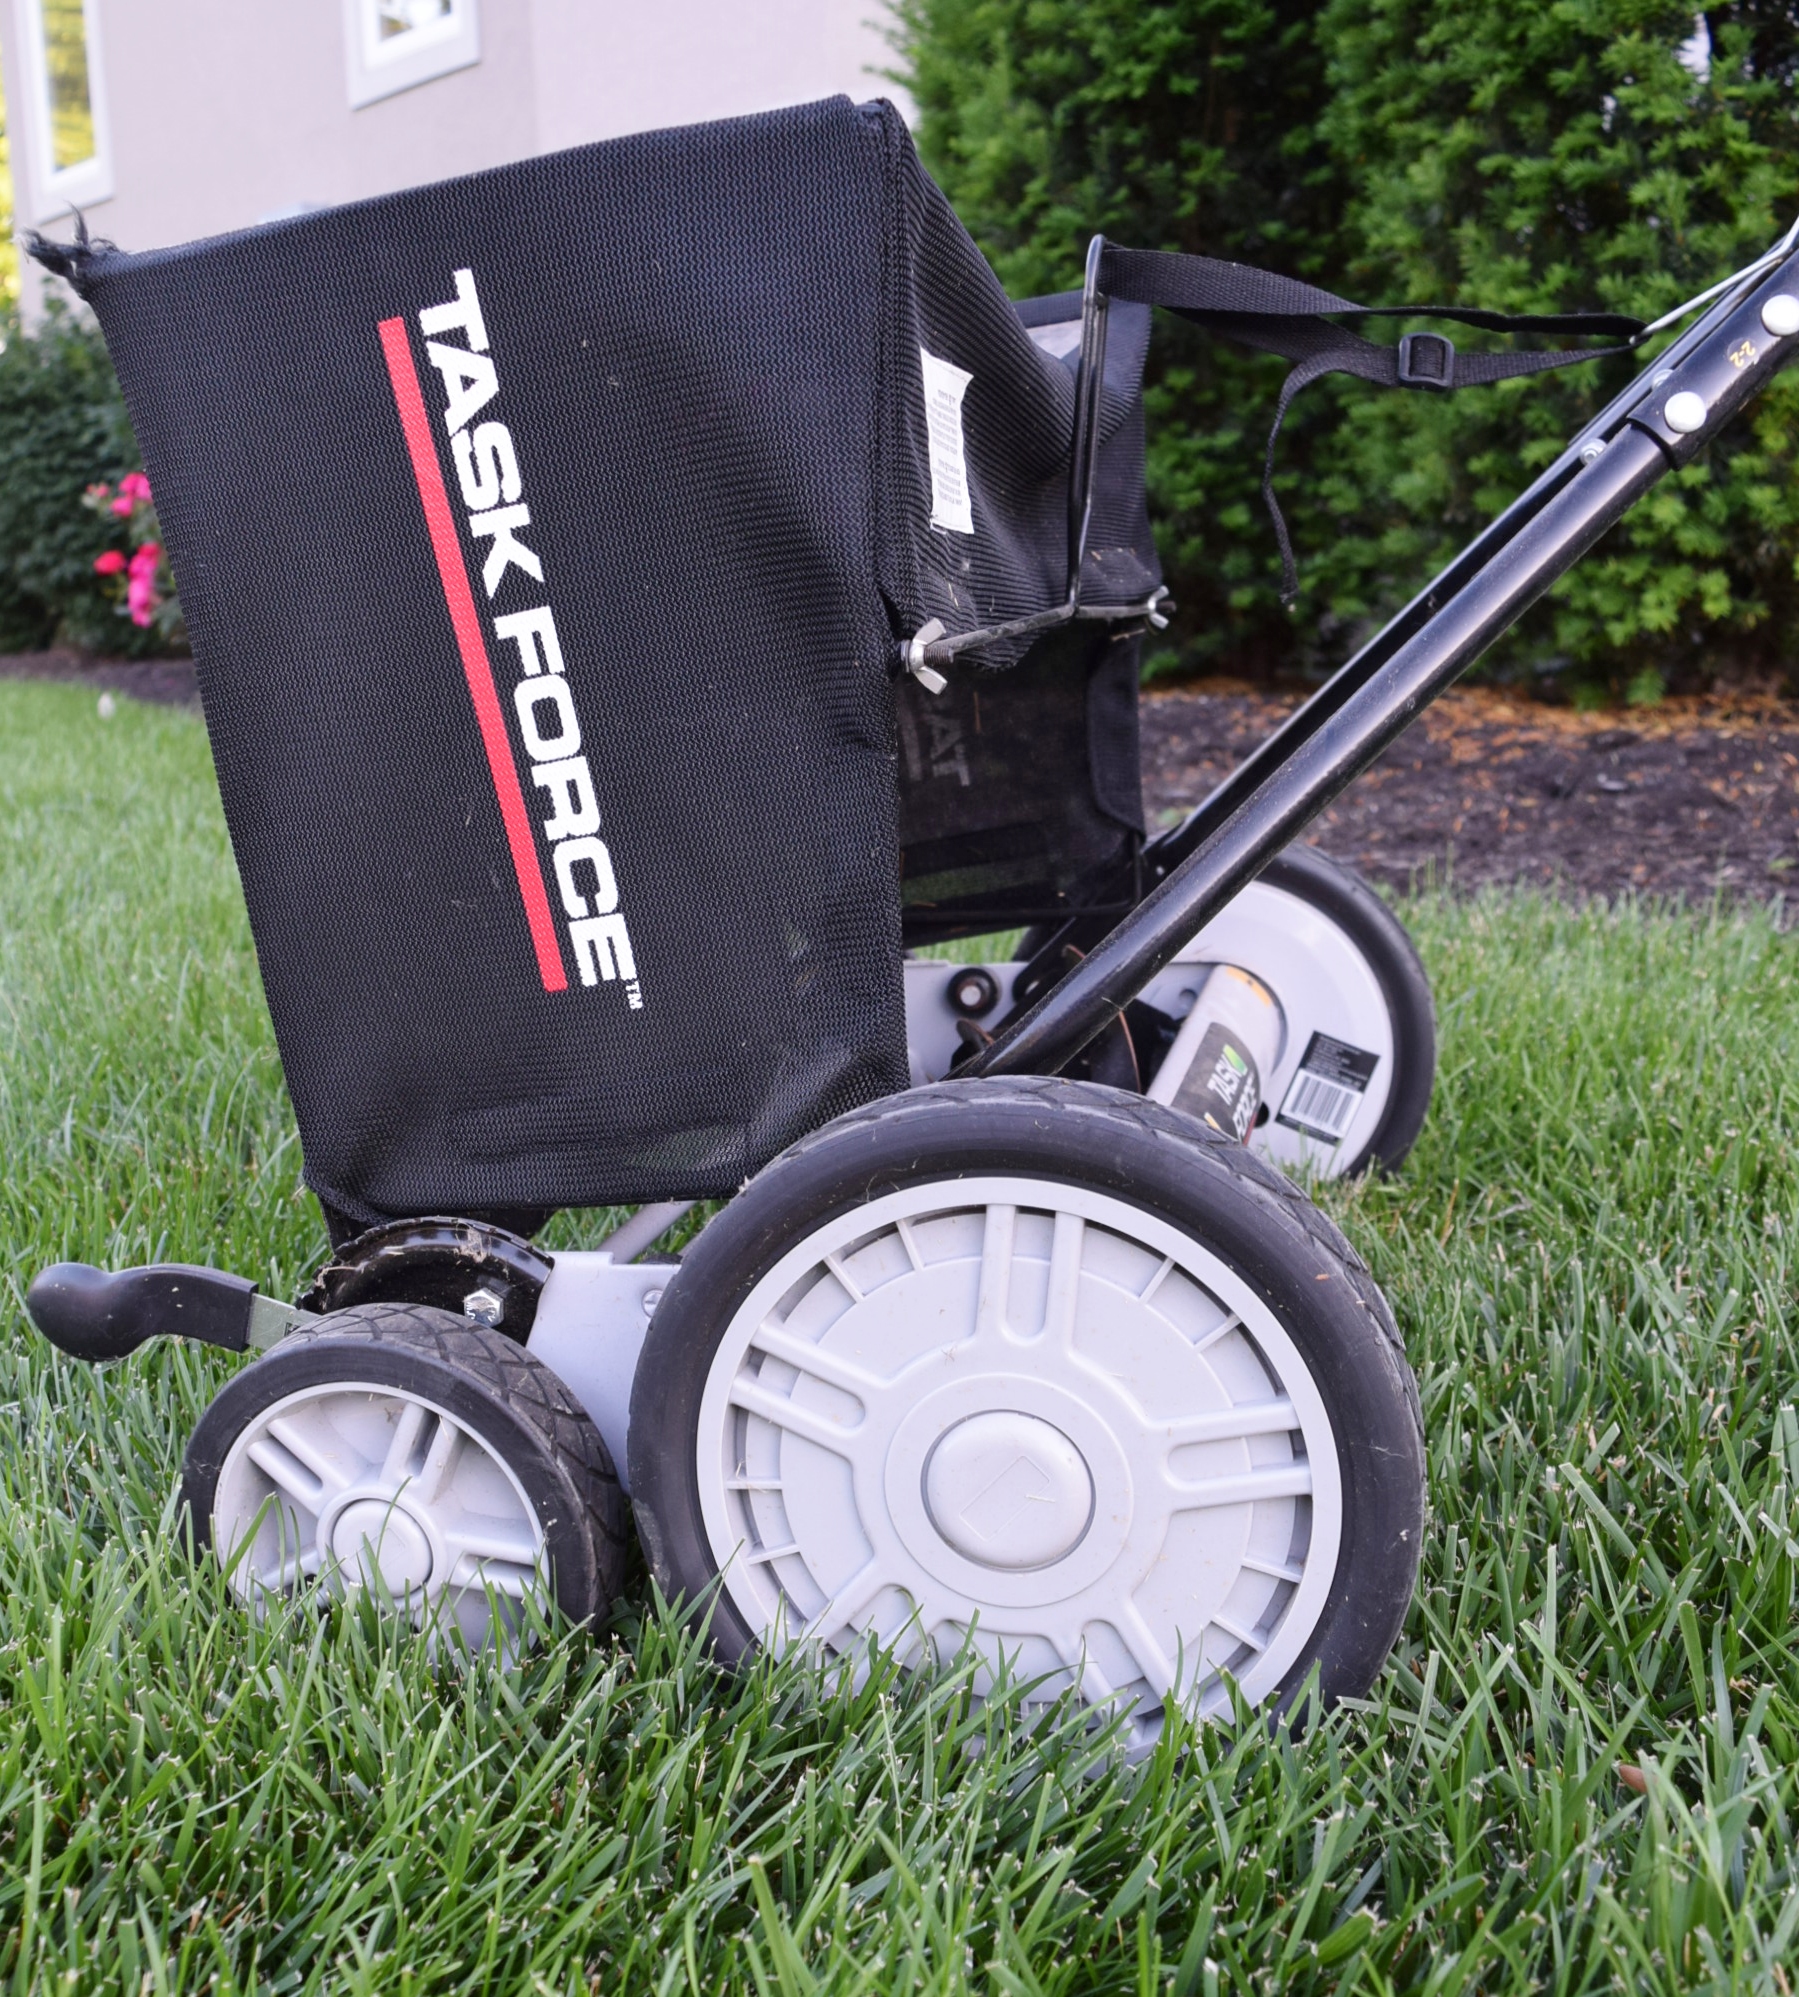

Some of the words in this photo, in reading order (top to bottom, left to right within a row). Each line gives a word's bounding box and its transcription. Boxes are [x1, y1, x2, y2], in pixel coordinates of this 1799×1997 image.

[1730, 340, 1756, 368] 2-2
[419, 268, 544, 599] TASK
[494, 605, 638, 987] FORCE
[1206, 1053, 1243, 1106] TASK
[1232, 1070, 1256, 1140] FORCE
